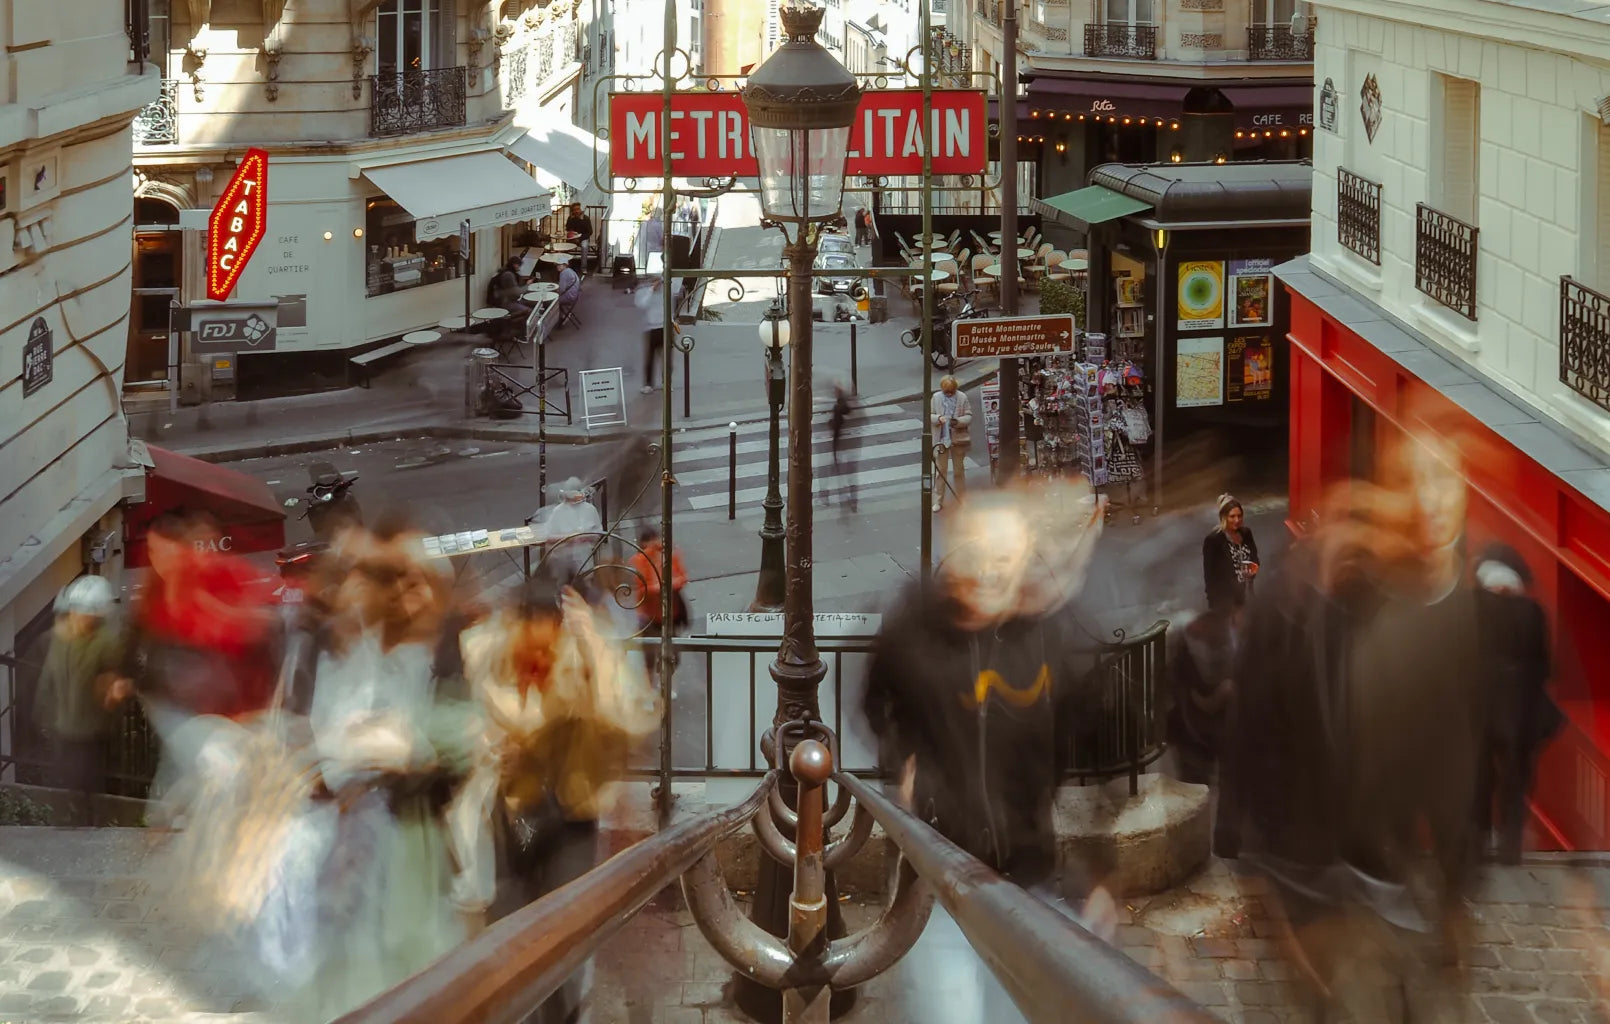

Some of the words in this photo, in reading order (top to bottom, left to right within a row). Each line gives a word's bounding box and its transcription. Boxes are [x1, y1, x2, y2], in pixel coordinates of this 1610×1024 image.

[1090, 99, 1116, 112] Rita
[1253, 113, 1282, 125] CAFE
[521, 203, 546, 215] QUARTIER
[220, 179, 257, 270] TABAC
[267, 265, 309, 274] QUARTIER
[202, 323, 236, 338] FDJ
[971, 326, 993, 334] Butte
[996, 324, 1042, 333] Montmartre
[971, 335, 997, 344] Musée
[1000, 333, 1046, 342] Montmartre
[971, 346, 984, 354] Par
[987, 344, 994, 353] la
[997, 345, 1010, 354] rue
[1030, 342, 1056, 351] Saules
[709, 613, 743, 623] PARIS
[746, 613, 760, 623] FC
